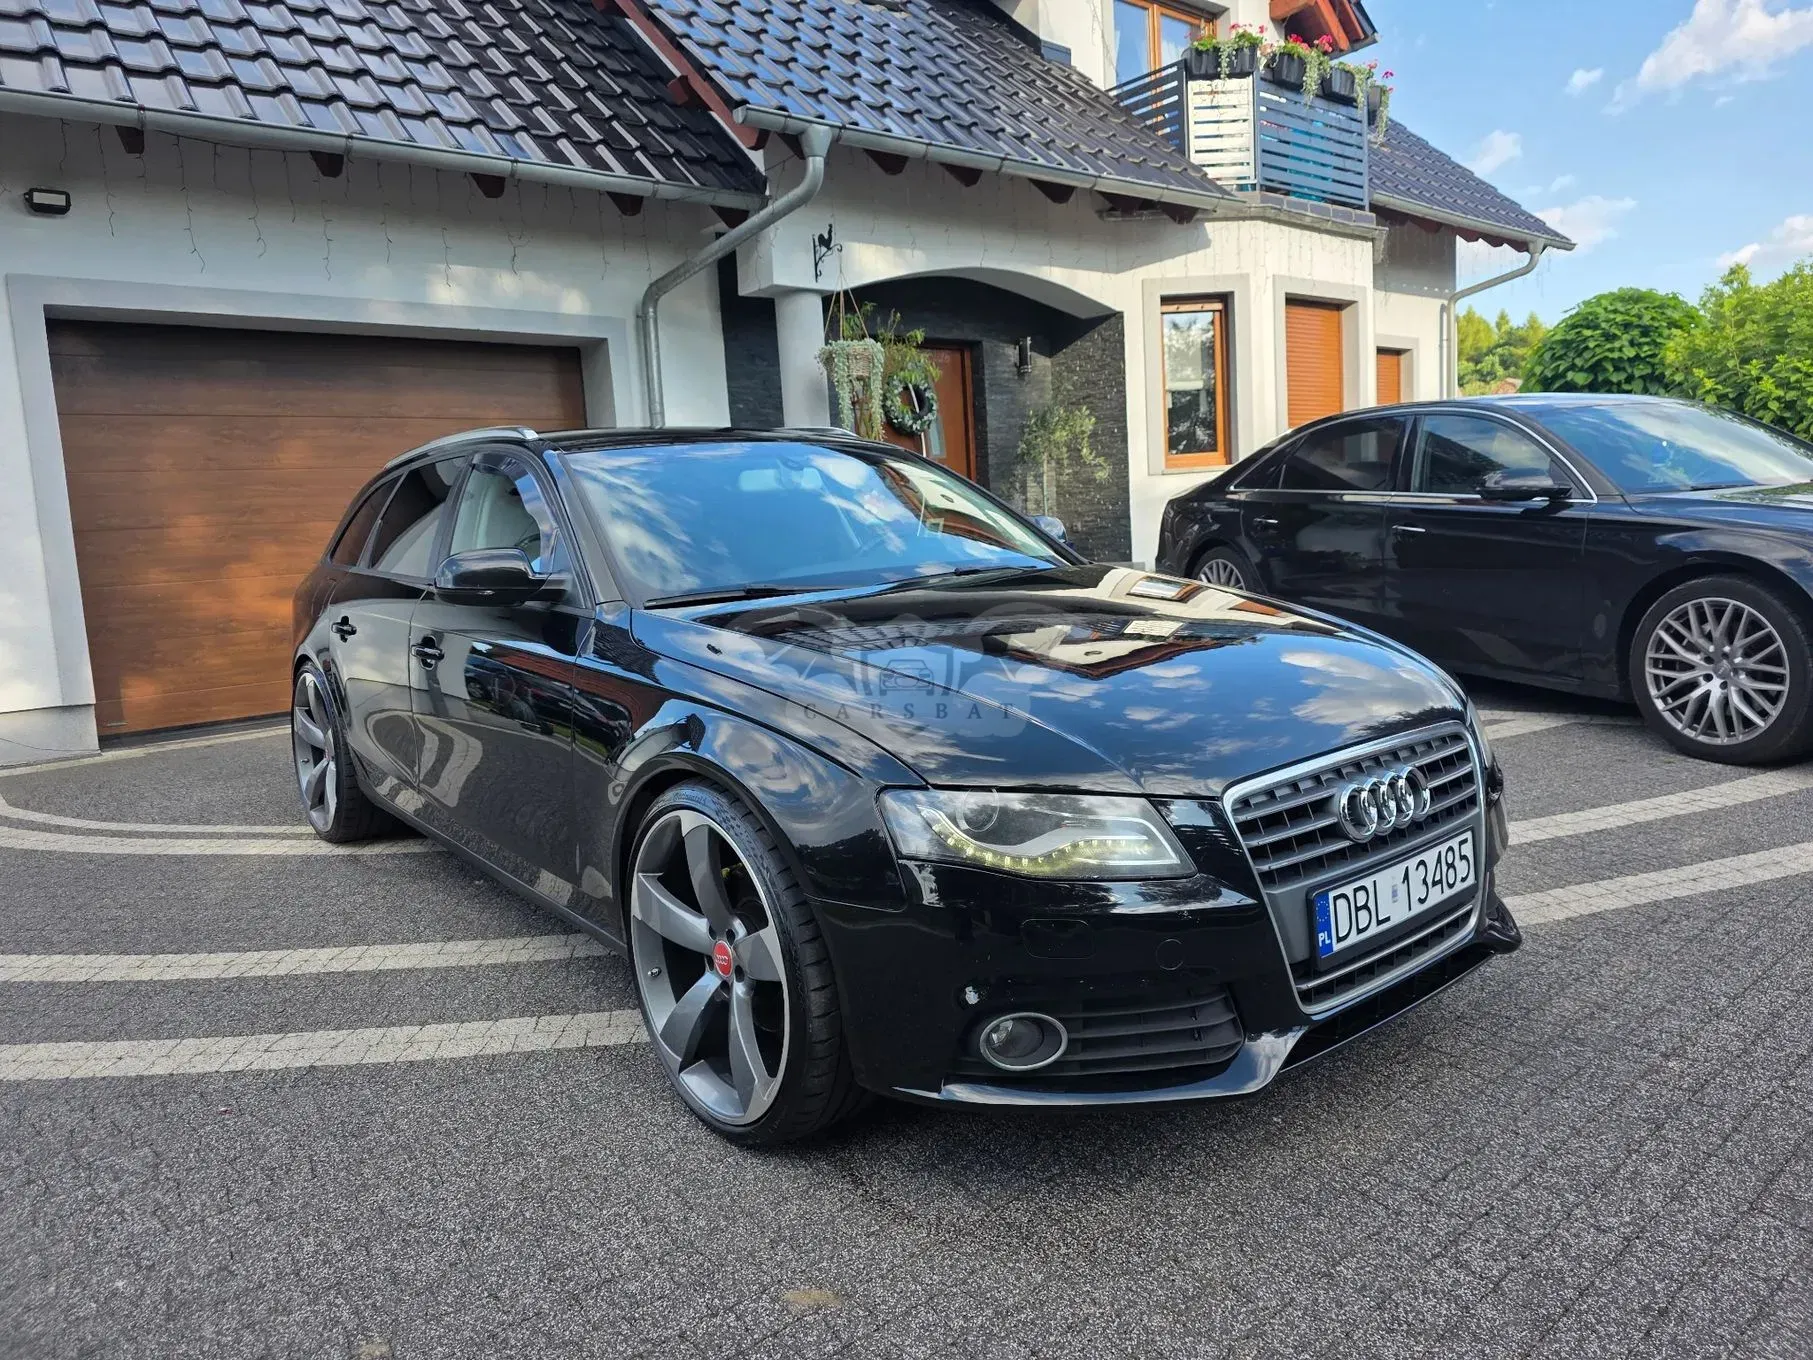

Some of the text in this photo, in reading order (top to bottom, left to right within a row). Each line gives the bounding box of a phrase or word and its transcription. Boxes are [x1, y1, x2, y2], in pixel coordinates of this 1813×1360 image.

[1332, 837, 1471, 944] DBL 13485
[1318, 932, 1331, 947] PL
